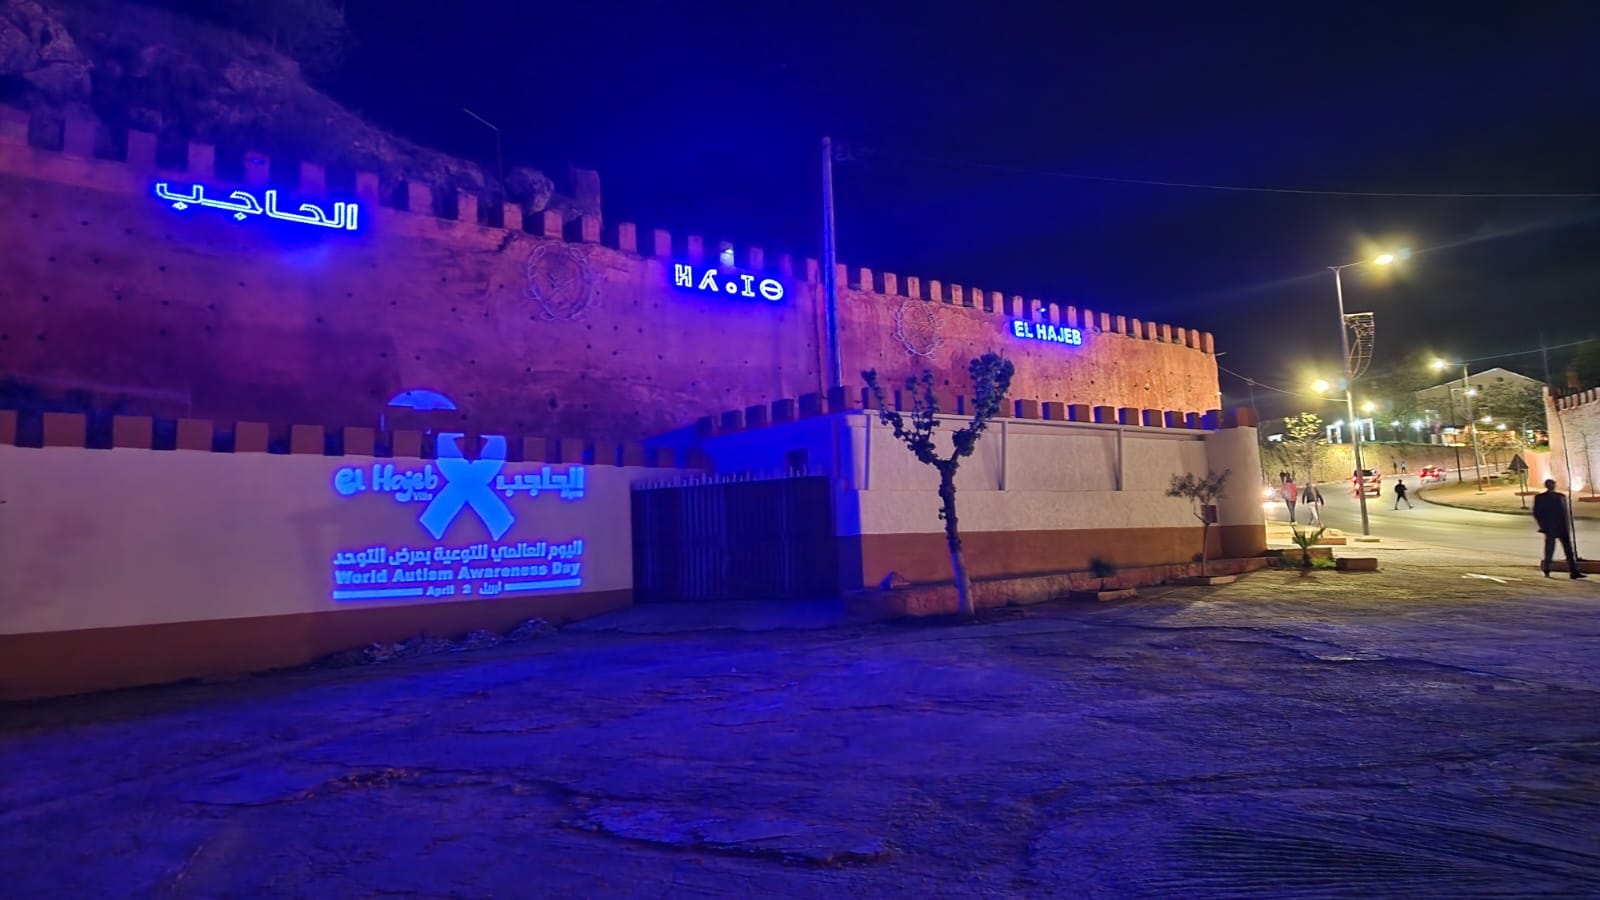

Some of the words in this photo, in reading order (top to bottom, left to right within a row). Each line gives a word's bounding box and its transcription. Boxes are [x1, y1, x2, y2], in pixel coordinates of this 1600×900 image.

[156, 182, 358, 231] الحاجب
[1014, 320, 1034, 338] EL
[1035, 323, 1082, 346] HAJEB
[496, 466, 585, 497] الحاجب
[333, 547, 387, 568] التوحد
[388, 547, 432, 566] بمرض
[434, 544, 488, 564] للتوعية
[491, 542, 546, 562] العالمي
[547, 540, 582, 560] اليوم
[335, 569, 388, 584] World
[392, 567, 454, 582] Autism
[457, 565, 548, 580] Awareness
[551, 562, 581, 576] Day
[425, 584, 456, 597] April
[462, 584, 472, 594] 2
